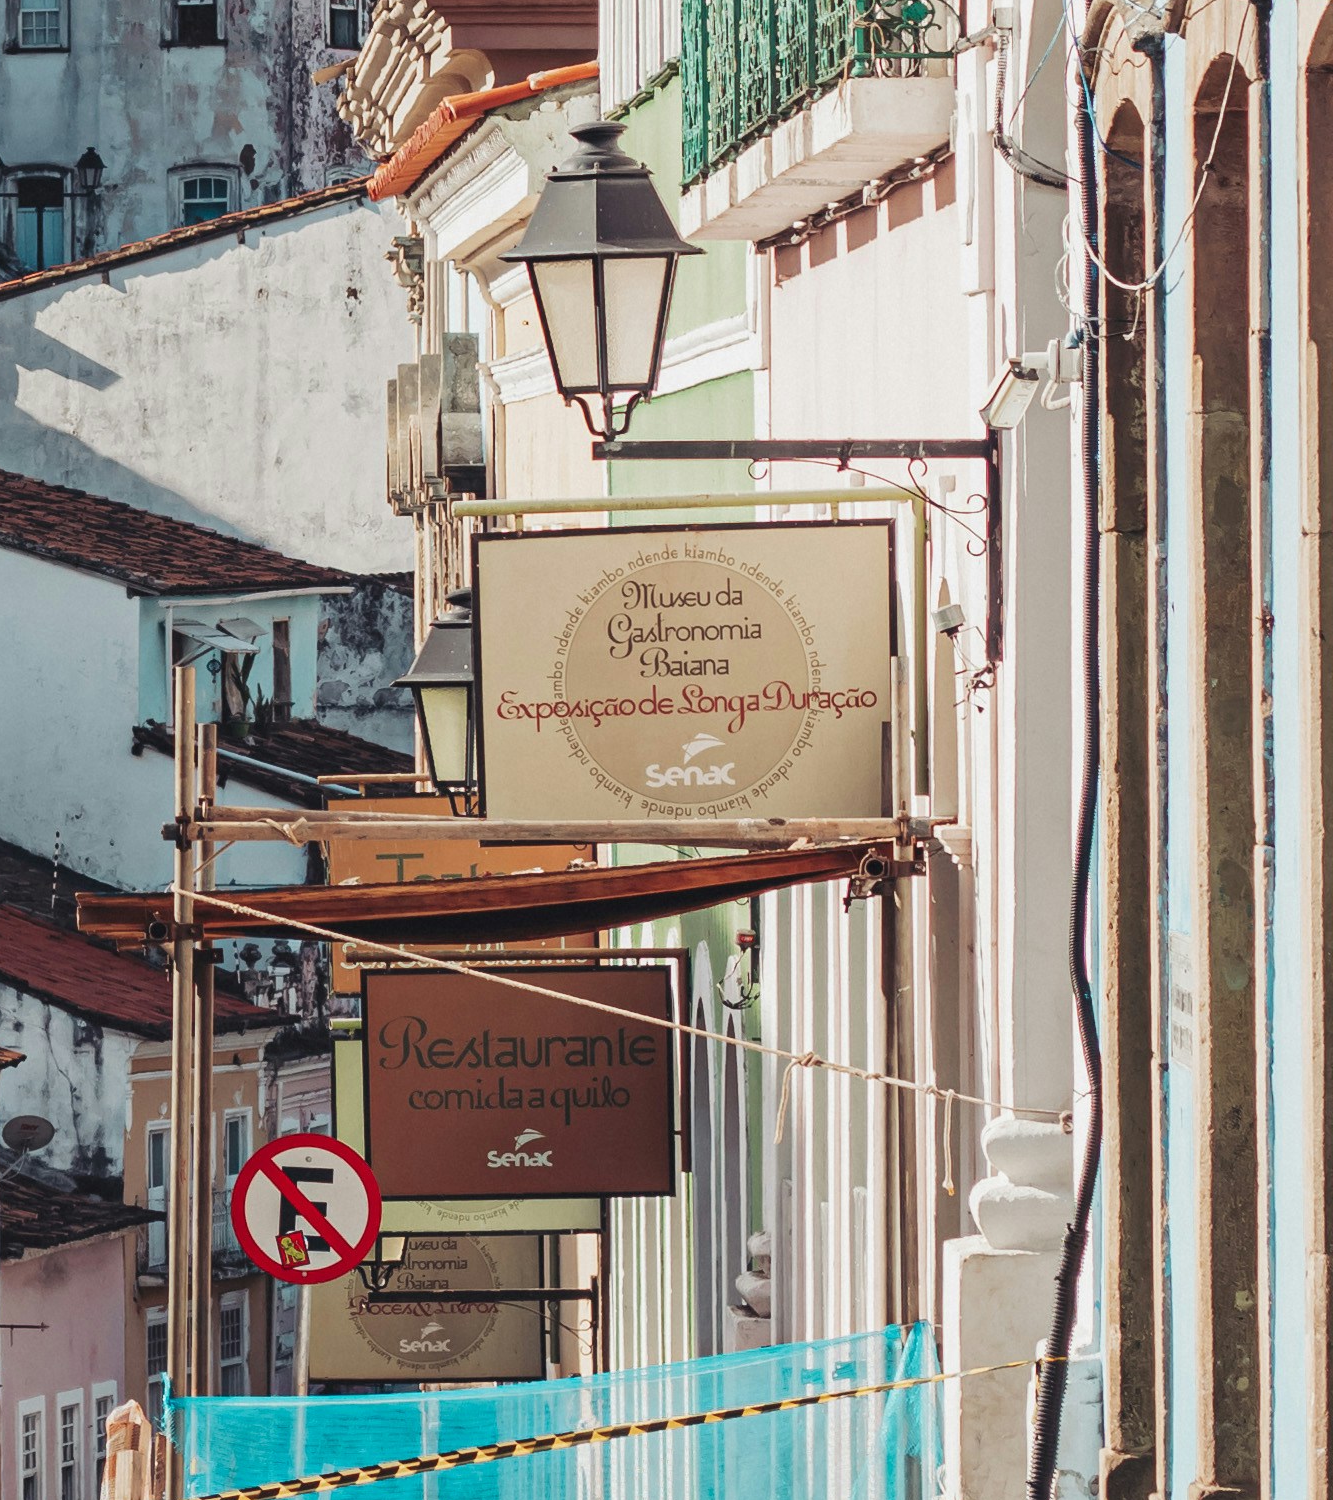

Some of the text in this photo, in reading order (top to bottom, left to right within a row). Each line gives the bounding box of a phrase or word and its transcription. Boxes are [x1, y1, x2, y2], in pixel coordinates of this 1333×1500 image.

[628, 543, 679, 571] ndende
[684, 543, 736, 567] kiambo
[577, 566, 624, 606] kiambo
[621, 577, 743, 610] Museu da
[739, 563, 785, 599] ndende
[554, 606, 584, 656] ndende
[607, 612, 762, 659] Gastronomia
[783, 594, 815, 647] kiambo
[639, 646, 730, 678] Baiana
[496, 680, 878, 734] Exposição de Longa Duração
[555, 717, 591, 766] ndende
[792, 708, 825, 758] kiambo
[589, 766, 634, 810] kiambo
[751, 758, 794, 800] ndende
[640, 799, 692, 820] ndende
[698, 794, 752, 819] kiambo
[378, 1015, 657, 1070] Restaurante
[408, 1075, 630, 1126] comida a quilo
[437, 1209, 471, 1226] ndende
[407, 1238, 440, 1250] useu
[441, 1236, 458, 1250] da
[396, 1272, 450, 1290] Baiana
